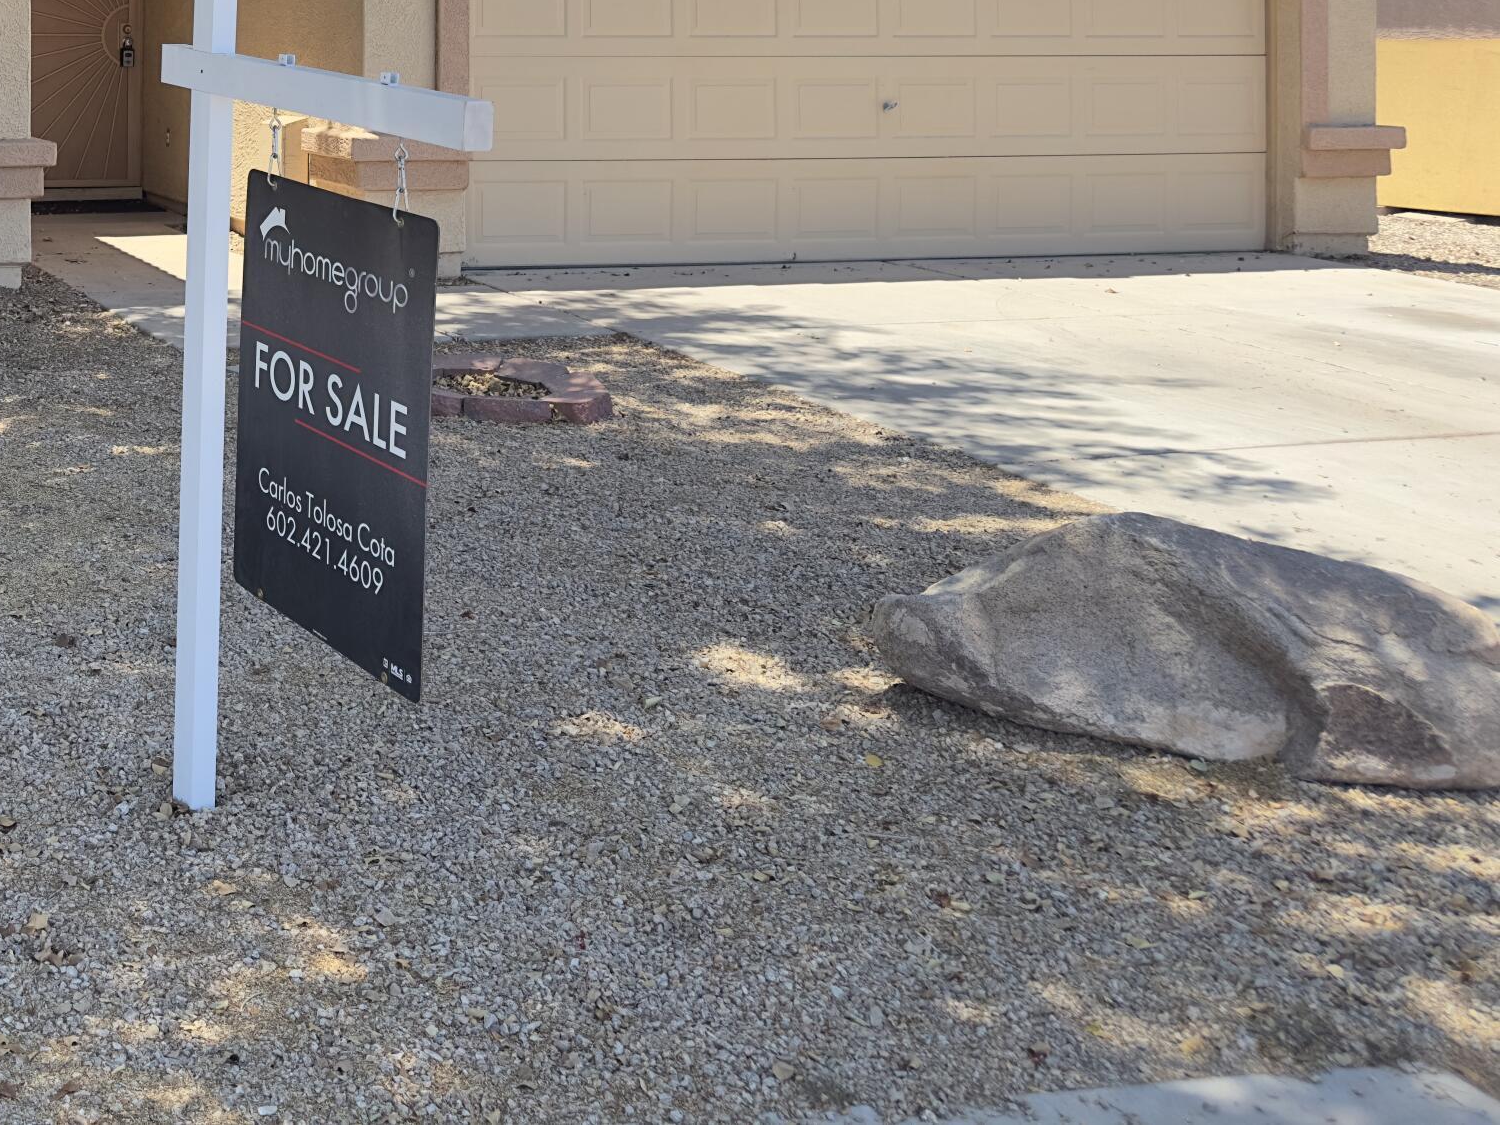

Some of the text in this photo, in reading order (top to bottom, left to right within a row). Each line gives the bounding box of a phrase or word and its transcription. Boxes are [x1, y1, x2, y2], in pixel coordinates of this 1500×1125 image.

[264, 238, 408, 314] myhomegroup
[255, 341, 408, 460] FOR SALE
[258, 467, 396, 567] Carlos Tolosa Cota
[266, 506, 384, 595] 602.421.4609
